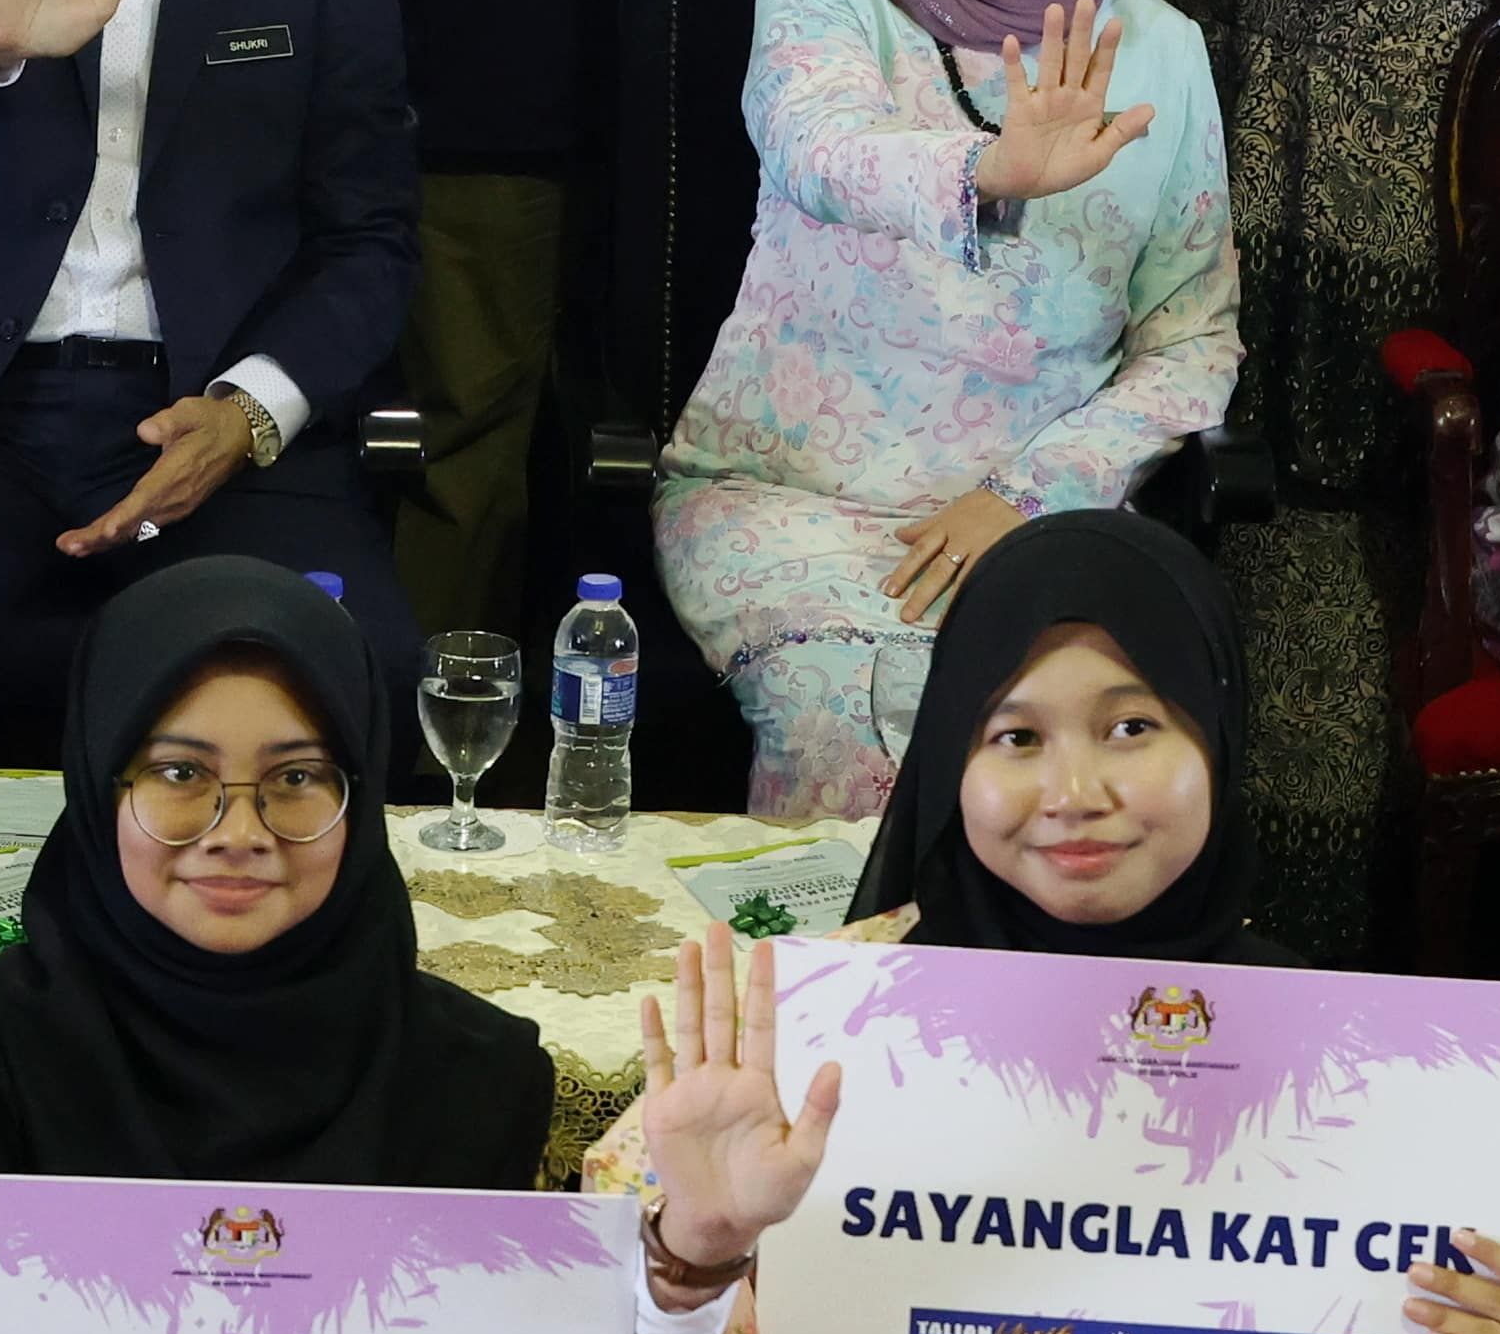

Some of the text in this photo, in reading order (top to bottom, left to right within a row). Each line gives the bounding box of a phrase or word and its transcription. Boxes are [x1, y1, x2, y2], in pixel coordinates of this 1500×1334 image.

[230, 38, 268, 52] SHUKRI
[841, 1186, 1192, 1259] SAYANGLA
[1210, 1211, 1338, 1268] KAT
